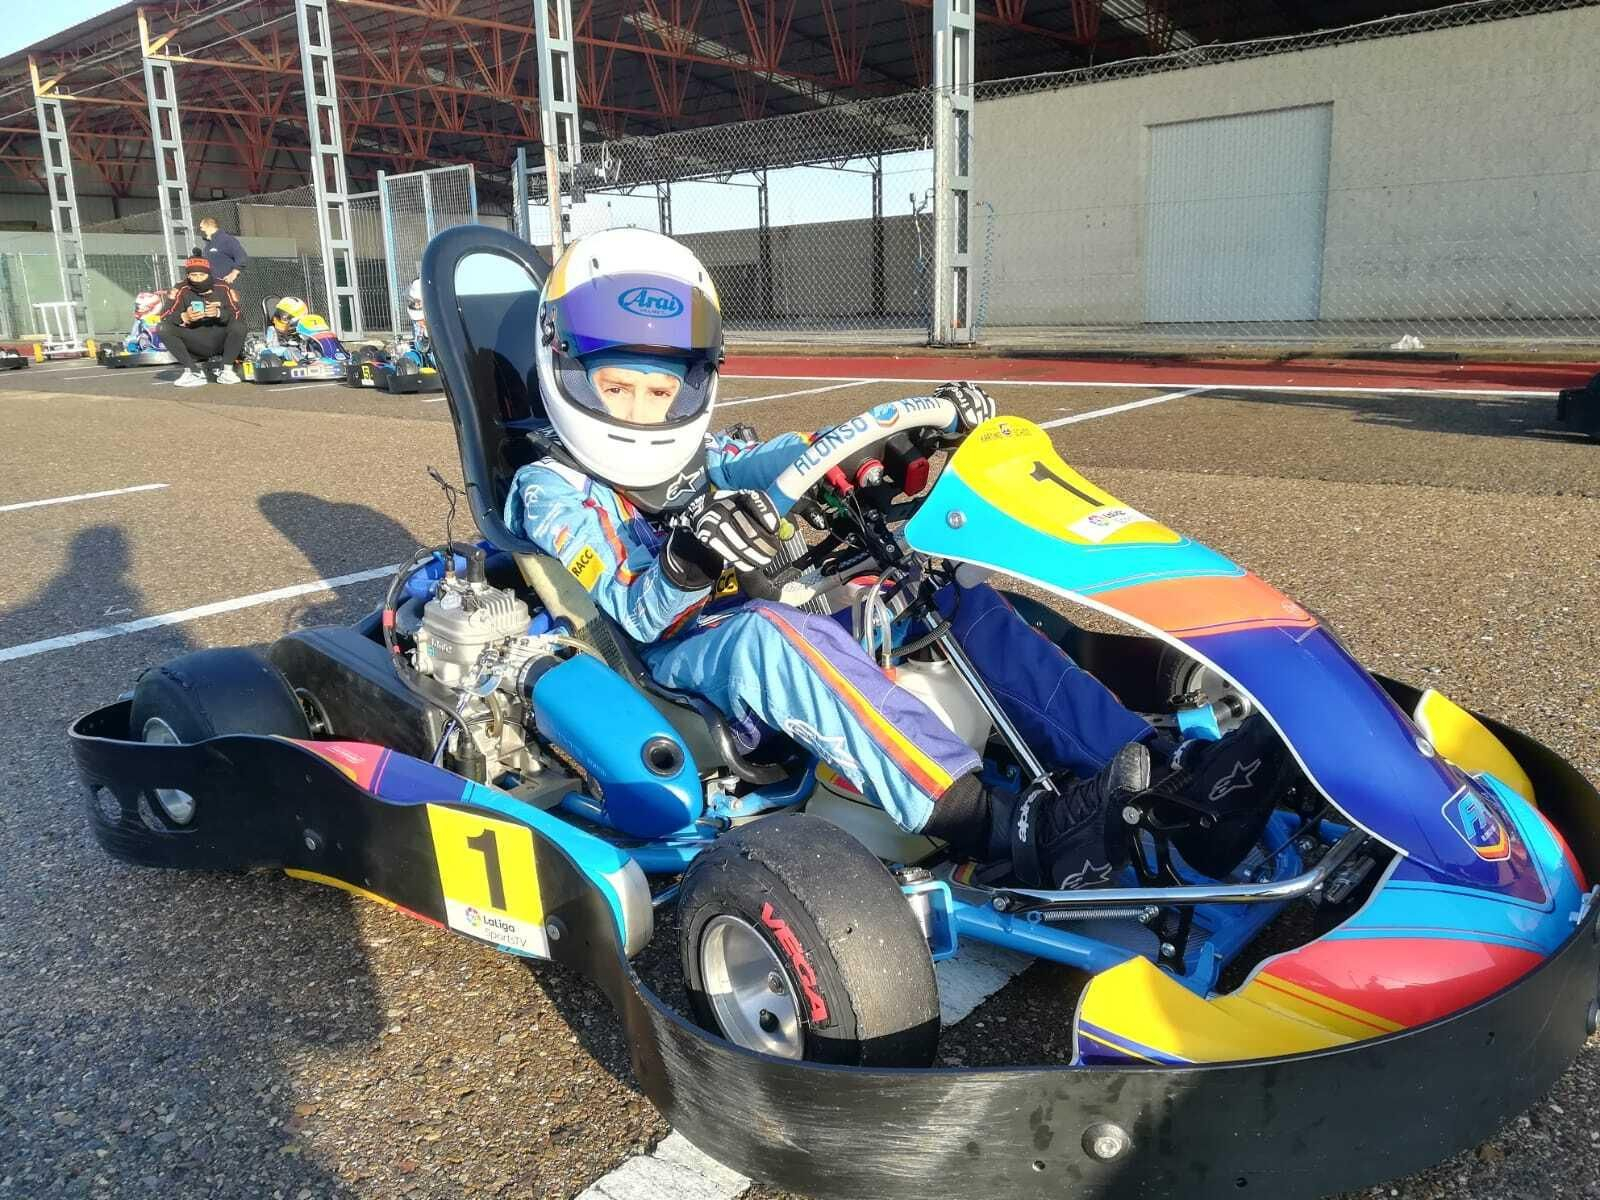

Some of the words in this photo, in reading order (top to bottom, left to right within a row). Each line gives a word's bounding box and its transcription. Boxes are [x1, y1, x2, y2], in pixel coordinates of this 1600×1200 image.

[624, 288, 677, 312] Arai
[793, 416, 869, 476] ALONSO
[1029, 461, 1105, 507] 1
[571, 549, 594, 577] RACC
[467, 828, 507, 912] 1
[483, 914, 515, 933] LaLiga
[762, 902, 828, 1023] VEGA
